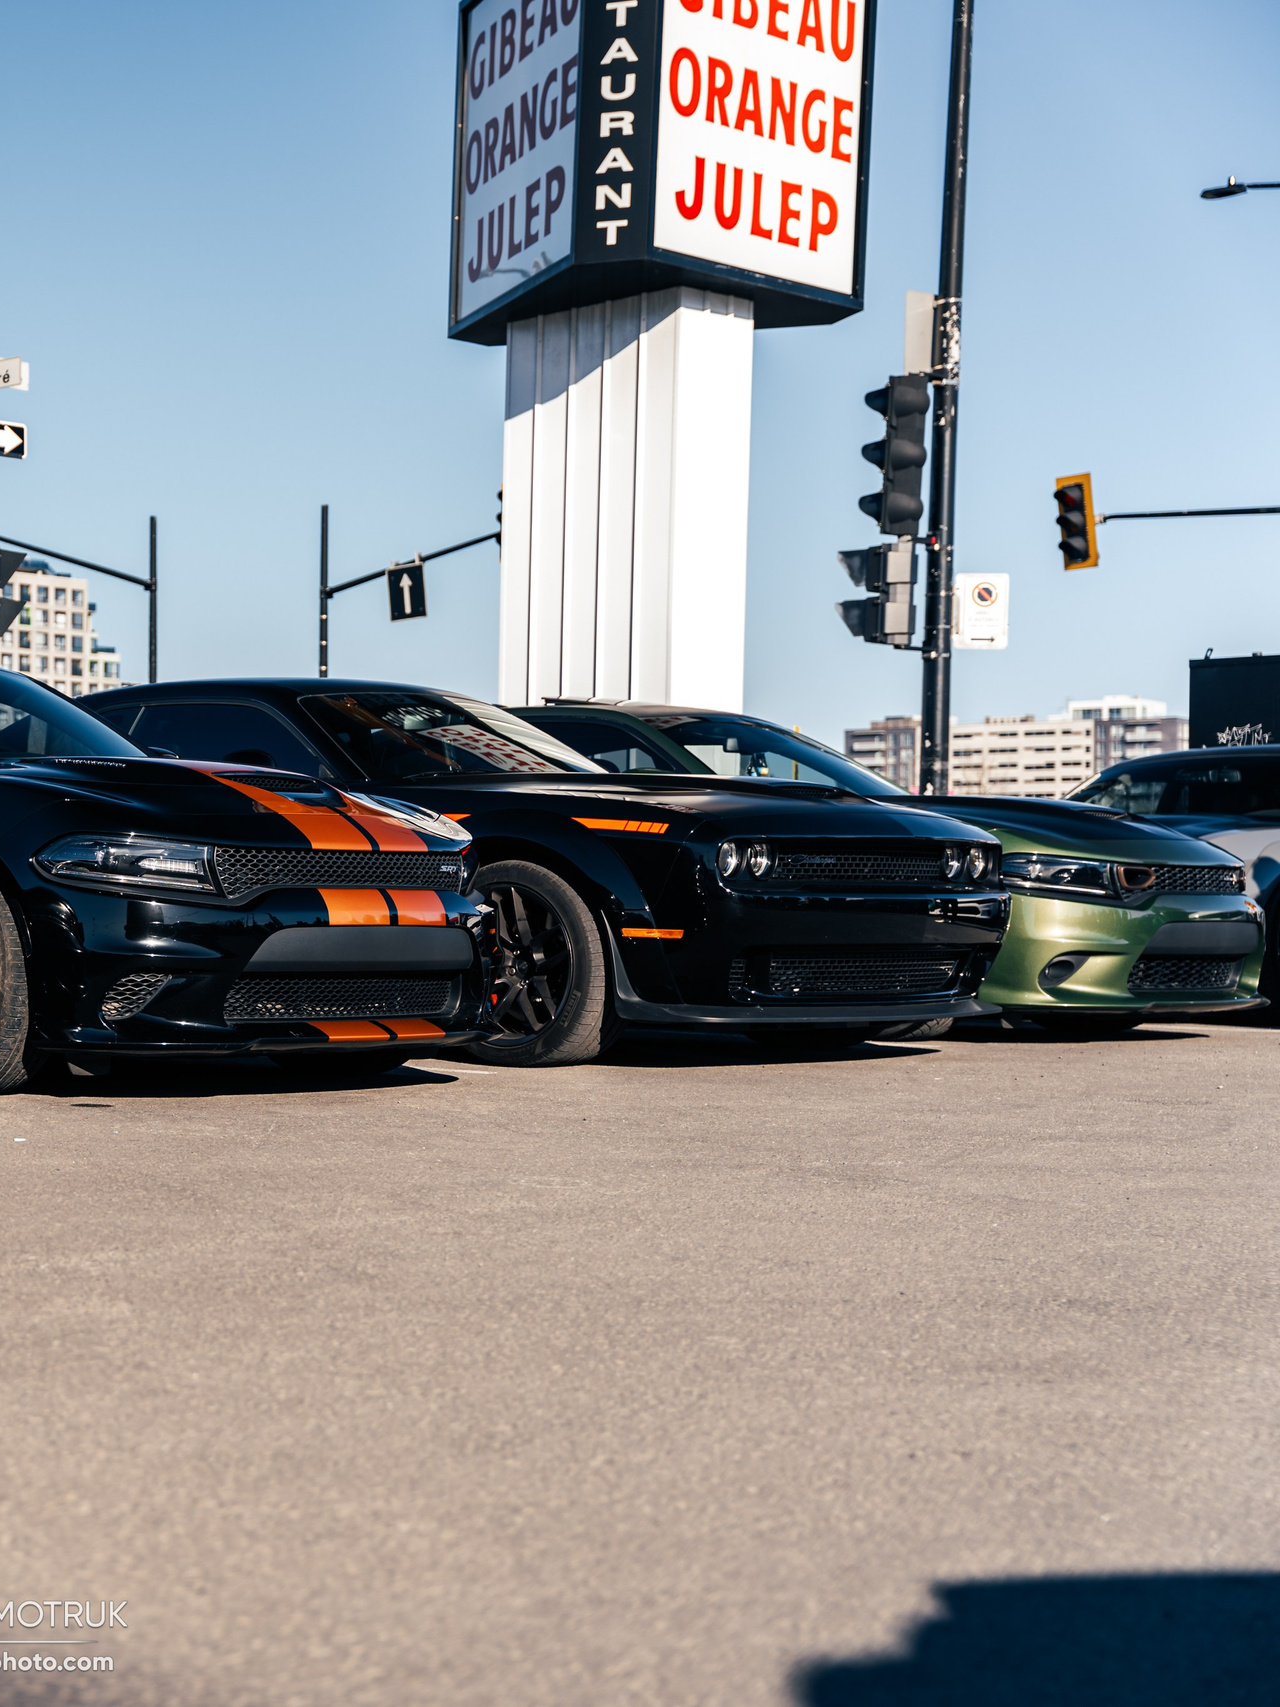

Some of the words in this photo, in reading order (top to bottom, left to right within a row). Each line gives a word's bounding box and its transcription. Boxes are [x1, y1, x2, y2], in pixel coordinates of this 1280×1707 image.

[679, 0, 855, 62] EAU
[466, 53, 578, 195] ORANGE
[669, 47, 854, 163] ORANGE
[467, 165, 566, 283] JULEP
[675, 156, 839, 252] JULEP
